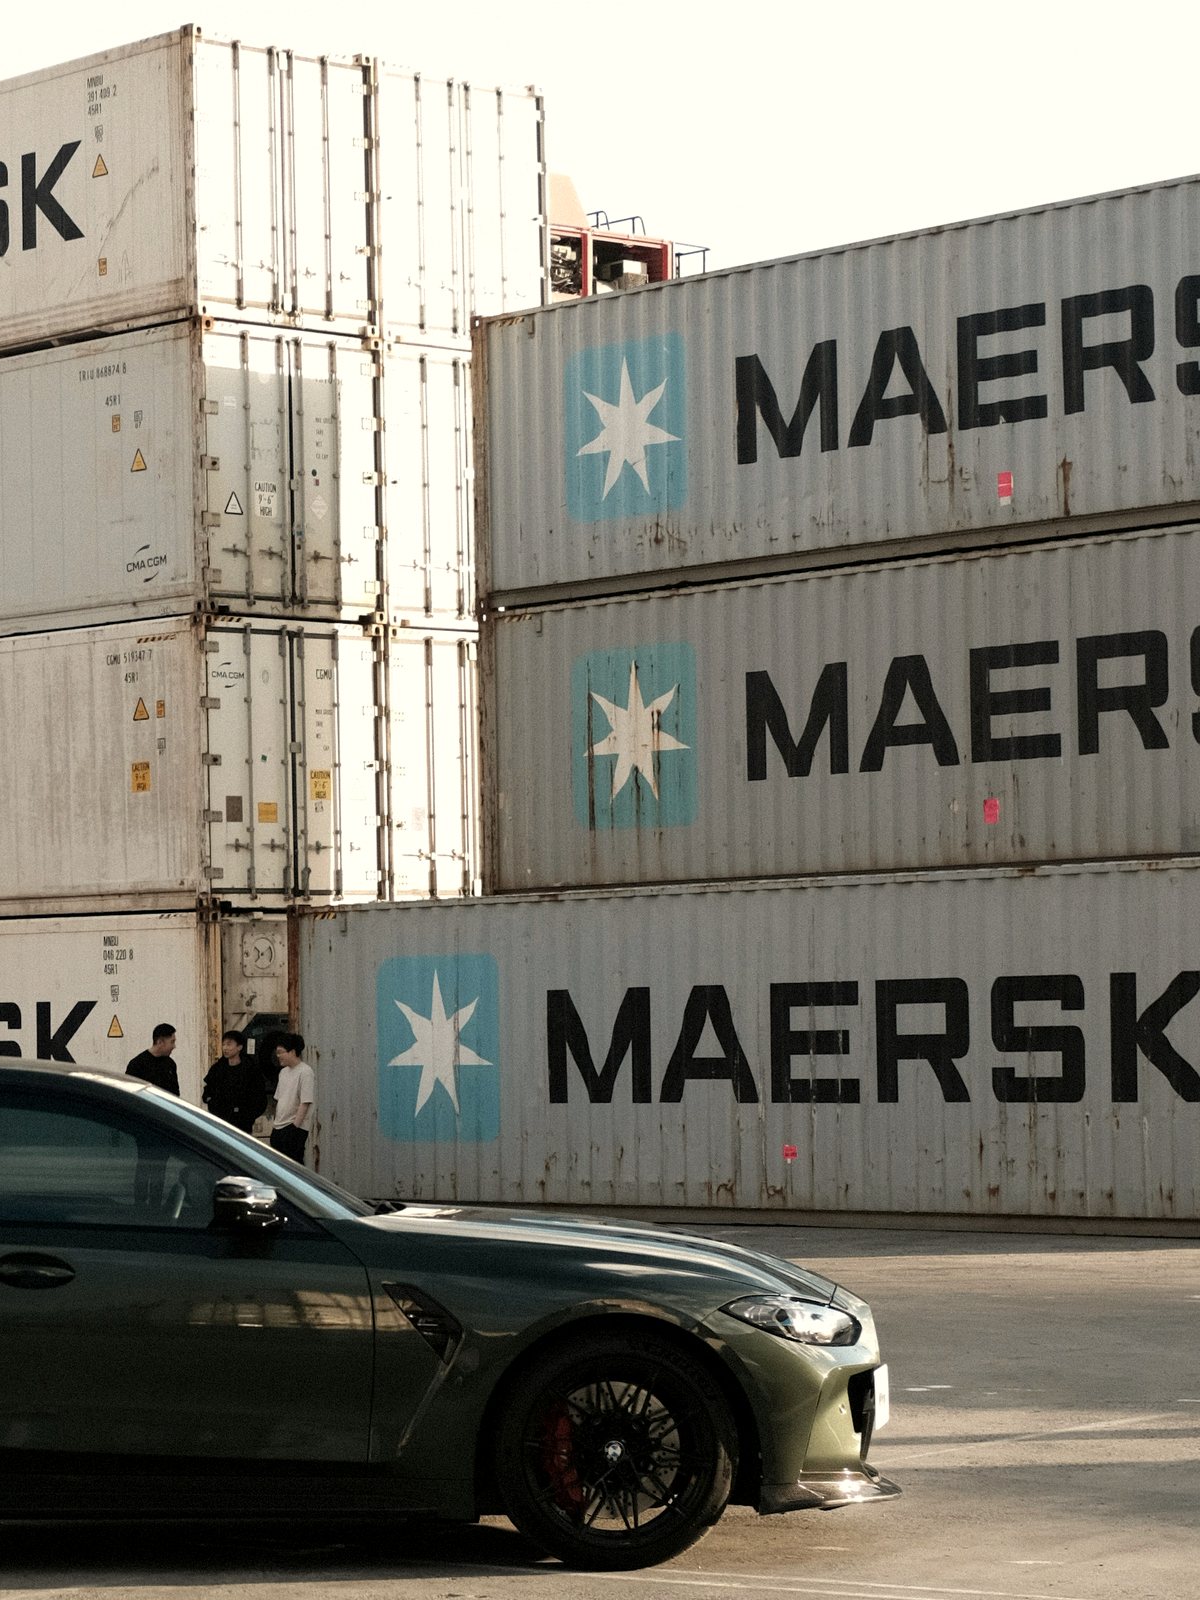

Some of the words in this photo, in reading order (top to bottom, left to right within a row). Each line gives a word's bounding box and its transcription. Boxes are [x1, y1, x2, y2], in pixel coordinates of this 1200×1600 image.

[735, 274, 1200, 465] MAER
[105, 394, 121, 407] 45R1
[254, 481, 277, 493] CAUTION
[126, 559, 146, 573] CMA
[146, 554, 168, 569] CGM
[124, 671, 139, 684] 45R1
[211, 670, 227, 678] CMA
[228, 671, 245, 679] CGM
[315, 668, 332, 680] CGMU
[745, 624, 1200, 781] MAER
[546, 970, 1200, 1105] MAERSK
